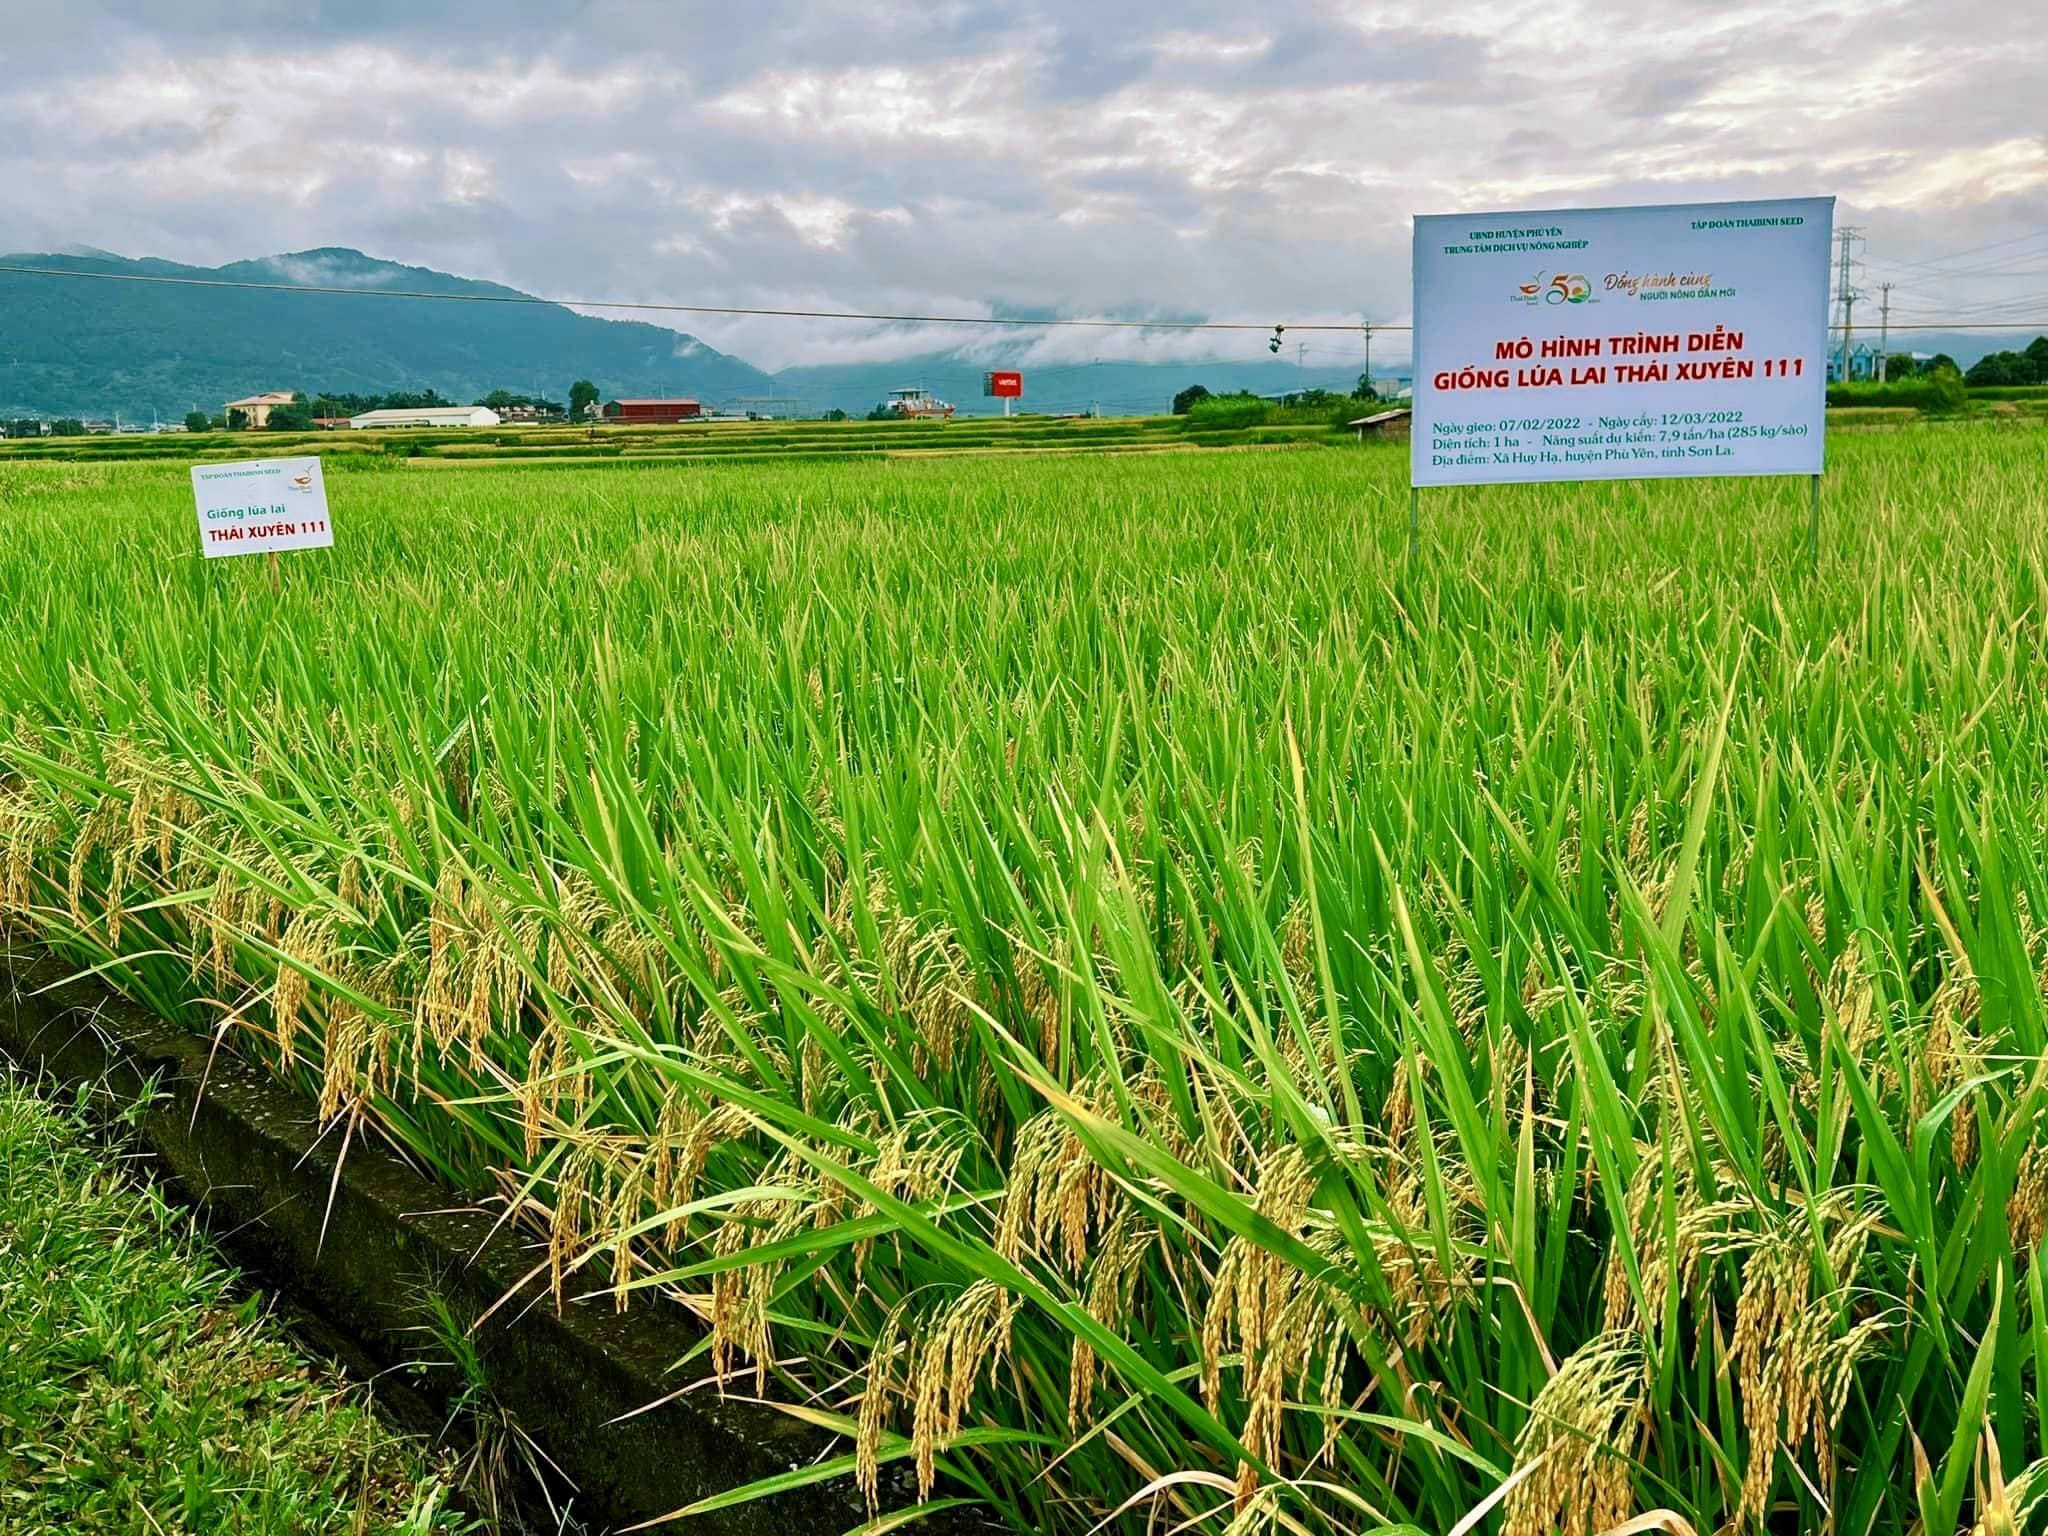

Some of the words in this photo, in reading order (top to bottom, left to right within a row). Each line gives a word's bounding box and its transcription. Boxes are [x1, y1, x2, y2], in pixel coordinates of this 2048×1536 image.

[1469, 231, 1494, 240] UBND
[1495, 229, 1525, 240] HUYỆN
[1545, 226, 1563, 237] YÊN
[1736, 218, 1778, 227] THAIBINH
[1779, 217, 1804, 226] SEED
[1444, 245, 1473, 255] TRUNG
[1474, 243, 1493, 253] TÂM
[1493, 243, 1515, 254] DỊCH
[1515, 242, 1529, 252] VỤ
[1529, 241, 1555, 251] NÔNG
[1555, 240, 1589, 250] NGHIỆP
[1604, 271, 1640, 296] Đồng
[1641, 272, 1677, 289] hành
[1680, 272, 1713, 289] cùng
[1670, 289, 1696, 300] NÔNG
[1718, 287, 1736, 298] MỚI
[1495, 336, 1533, 360] MÔ
[1541, 335, 1601, 358] HÌNH
[1608, 332, 1680, 355] TRÌNH
[1687, 325, 1744, 352] DIỄN
[1434, 364, 1509, 390] GIỐNG
[1518, 364, 1563, 387] LÚA
[1570, 366, 1607, 385] LAI
[1614, 360, 1668, 383] THÁI
[1675, 357, 1753, 381] XUYÊN
[1763, 358, 1803, 377] 111
[1433, 421, 1464, 435] Ngày
[1466, 421, 1497, 434] gieo:
[1500, 418, 1581, 432] 07/02/2022
[1599, 416, 1630, 430] Ngày
[1632, 412, 1657, 428] cấy:
[1661, 411, 1743, 425] 12/03/2022
[1433, 439, 1462, 451] Diện
[1464, 436, 1490, 449] tích:
[1494, 437, 1500, 448] 1
[1504, 436, 1520, 447] ha
[1543, 434, 1575, 448] Năng
[1578, 430, 1604, 445] suất
[1606, 432, 1622, 444] dự
[1625, 429, 1656, 443] kiến:
[1659, 430, 1680, 443] 7,9
[1683, 426, 1725, 441] tấn/ha
[1727, 425, 1757, 441] (285
[1760, 423, 1808, 439] kg/sào)
[1432, 455, 1453, 468] Địa
[1456, 453, 1490, 466] điểm:
[1493, 452, 1510, 464] Xã
[1513, 452, 1537, 465] Huy
[1540, 451, 1562, 465] Hạ,
[1565, 450, 1602, 465] huyện
[1631, 447, 1659, 460] Yên,
[1715, 444, 1735, 456] La.
[207, 507, 244, 520] Giống
[248, 506, 267, 516] lúa
[271, 504, 286, 514] lai
[208, 525, 243, 542] THÁI
[248, 521, 295, 539] XUYÊN
[301, 520, 325, 534] 111
